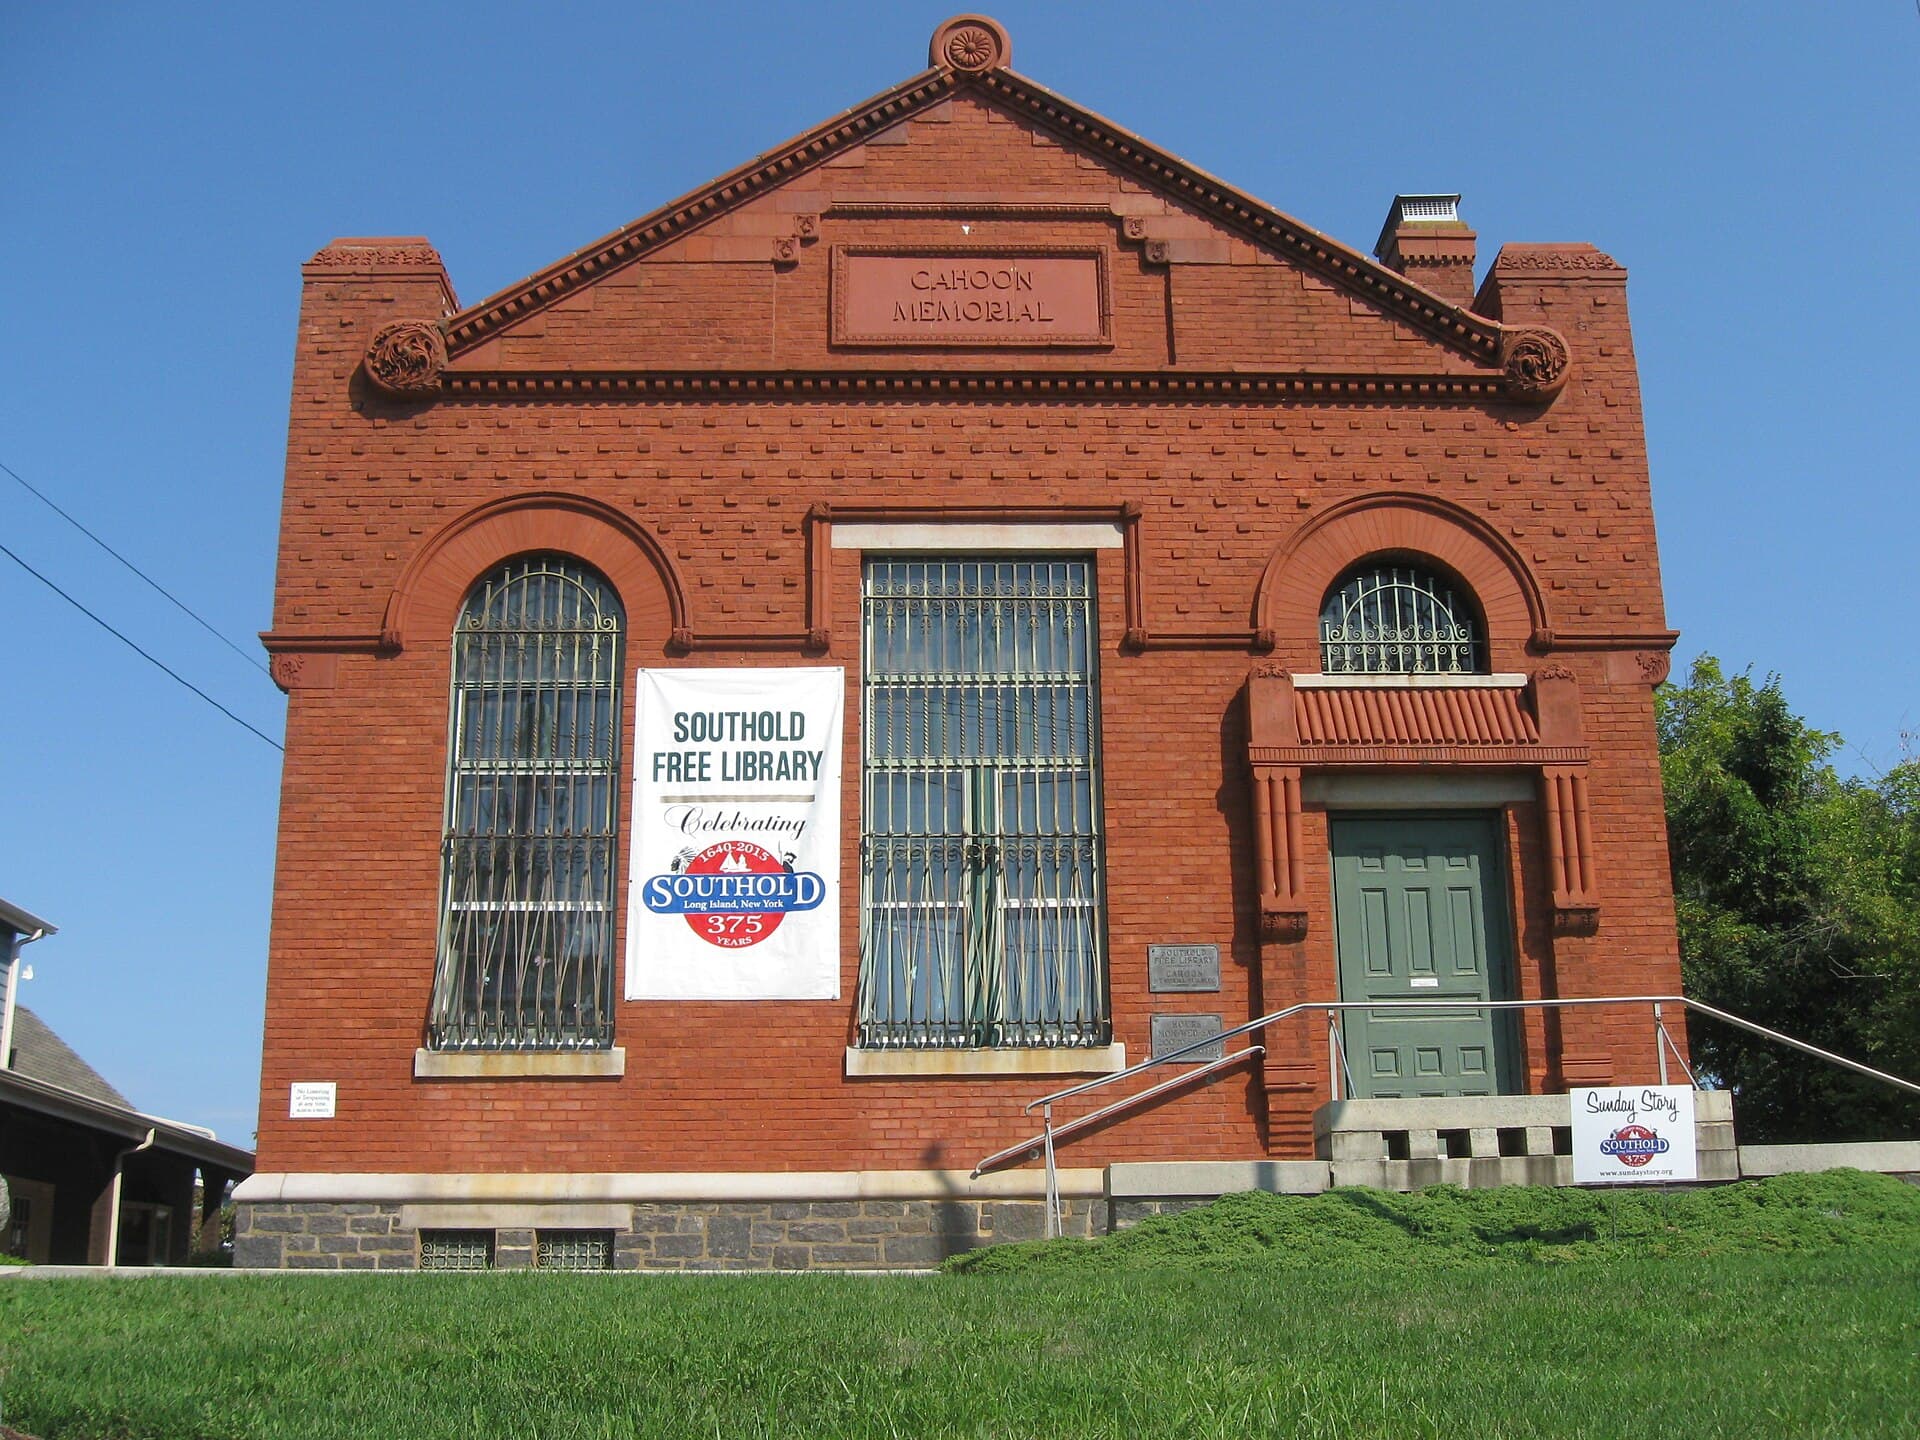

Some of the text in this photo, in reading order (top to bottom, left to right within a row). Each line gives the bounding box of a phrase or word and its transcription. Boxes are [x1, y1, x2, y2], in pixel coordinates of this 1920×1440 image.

[911, 270, 1033, 291] CAHOON
[893, 300, 1054, 322] MEMORIAL
[674, 711, 805, 743] SOUTHOLD
[653, 750, 823, 782] FREE LIBRARY
[664, 804, 808, 841] Celebrating
[700, 842, 770, 862] 1640-2015
[651, 874, 821, 907] SOUTHOLD
[684, 900, 784, 911] Long Island, New York
[707, 914, 763, 934] 375
[716, 936, 753, 946] YEARS
[1586, 1089, 1680, 1124] Sunday Story
[1602, 1139, 1668, 1153] SOUTHOLD
[1625, 1154, 1647, 1163] 375
[1599, 1168, 1673, 1177] www.sundaystory.org
